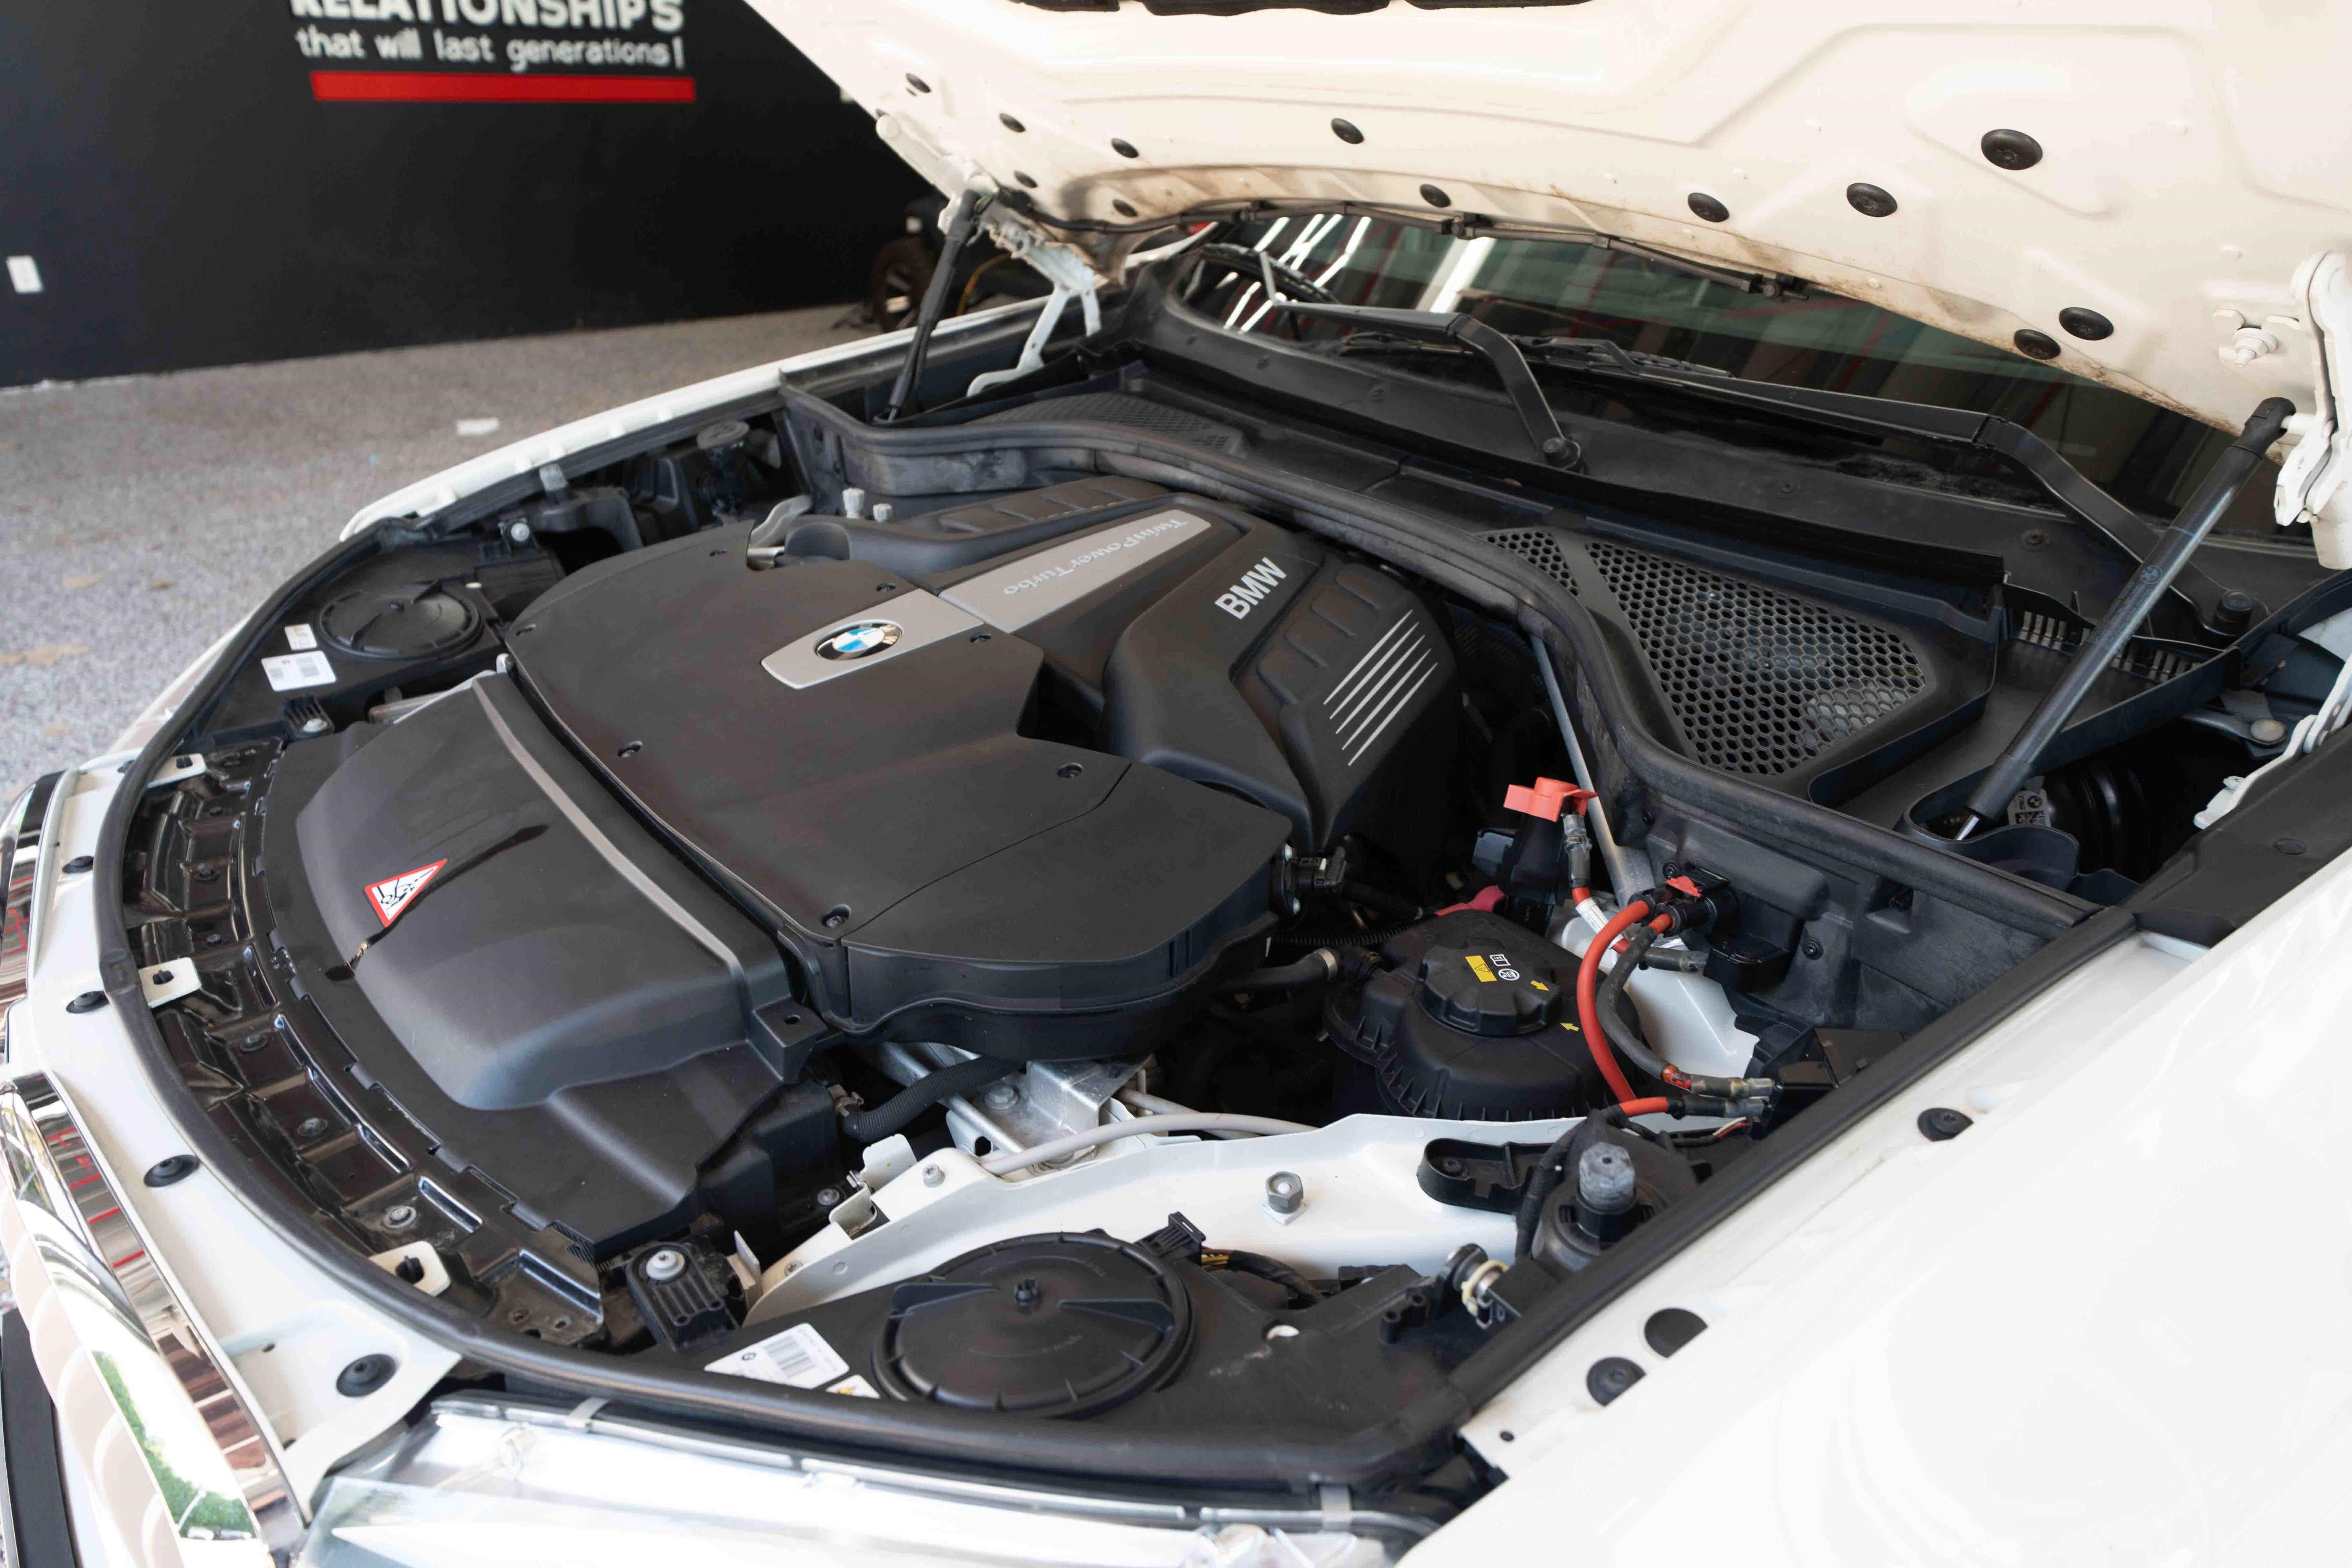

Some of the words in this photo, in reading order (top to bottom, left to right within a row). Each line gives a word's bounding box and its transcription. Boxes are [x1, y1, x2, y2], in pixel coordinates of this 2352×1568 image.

[295, 23, 365, 59] that
[374, 27, 423, 61] will
[433, 28, 495, 63] last
[1214, 557, 1286, 619] BMW
